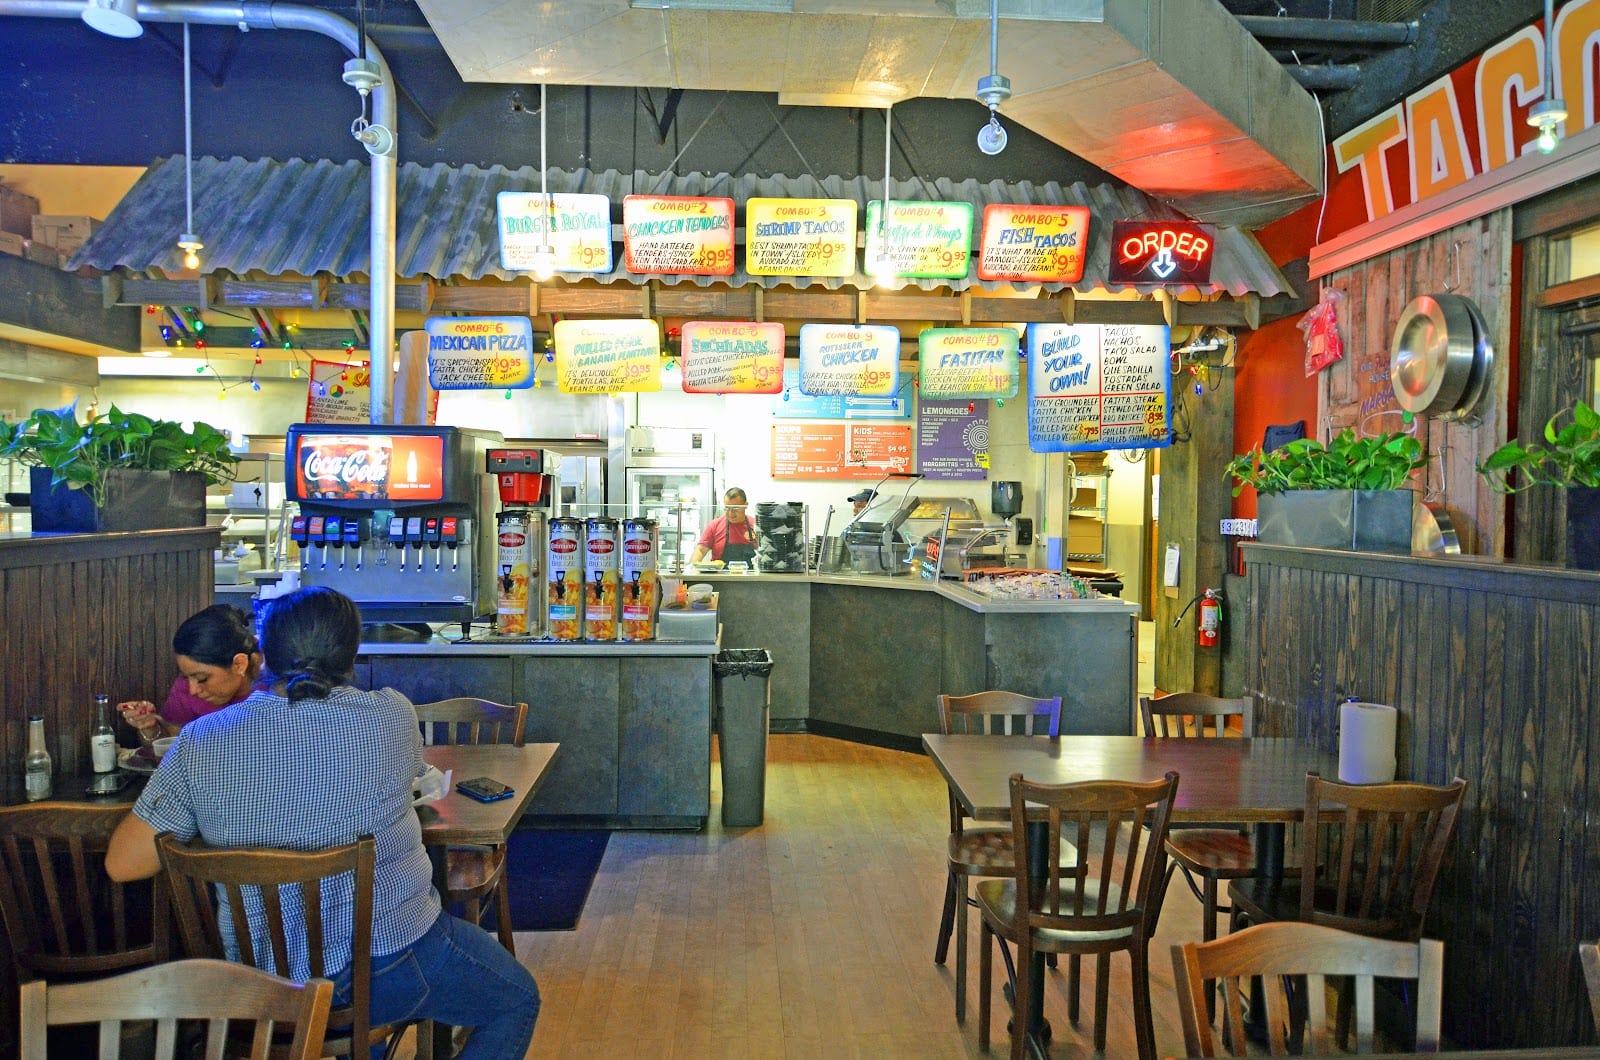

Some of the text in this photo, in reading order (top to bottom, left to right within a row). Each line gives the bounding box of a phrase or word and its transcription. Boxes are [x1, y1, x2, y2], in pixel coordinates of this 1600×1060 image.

[653, 202, 690, 211] COMBO
[776, 207, 810, 216] COMBO
[894, 207, 931, 216] COMBO
[1011, 214, 1053, 225] COMBO
[629, 214, 730, 238] CHICKEN TENDERS
[756, 220, 846, 237] SHRIMP TACOS
[998, 227, 1077, 248] FISH TACOS
[639, 242, 695, 250] HAND BATTERED
[1123, 230, 1208, 261] ORDER
[455, 324, 489, 333] COMBO
[709, 327, 745, 336] COMBO
[1105, 327, 1136, 337] TACOS
[826, 332, 860, 340] COMBO
[943, 336, 977, 345] COMBO
[429, 335, 528, 351] MEXICAN PIZZA
[691, 338, 770, 354] ENCHILADAS
[1041, 334, 1141, 358] BUILD NACHOS
[1104, 345, 1157, 356] TACO SALAD
[822, 347, 879, 368] CHICKEN
[940, 349, 1004, 368] FAJITAS
[1043, 352, 1128, 373] YOUR BOWL
[1049, 362, 1153, 392] OWN! QUESADILLA
[1104, 375, 1148, 384] TOSTADAS
[1104, 382, 1161, 393] GREEN SALAD
[1103, 395, 1158, 405] FAJITA STEAK
[922, 407, 969, 415] LEMONADES
[1060, 407, 1093, 415] CHICKEN
[1131, 405, 1164, 413] CHICKEN
[853, 427, 872, 435] KIDS
[304, 449, 389, 482] Coca-Cola
